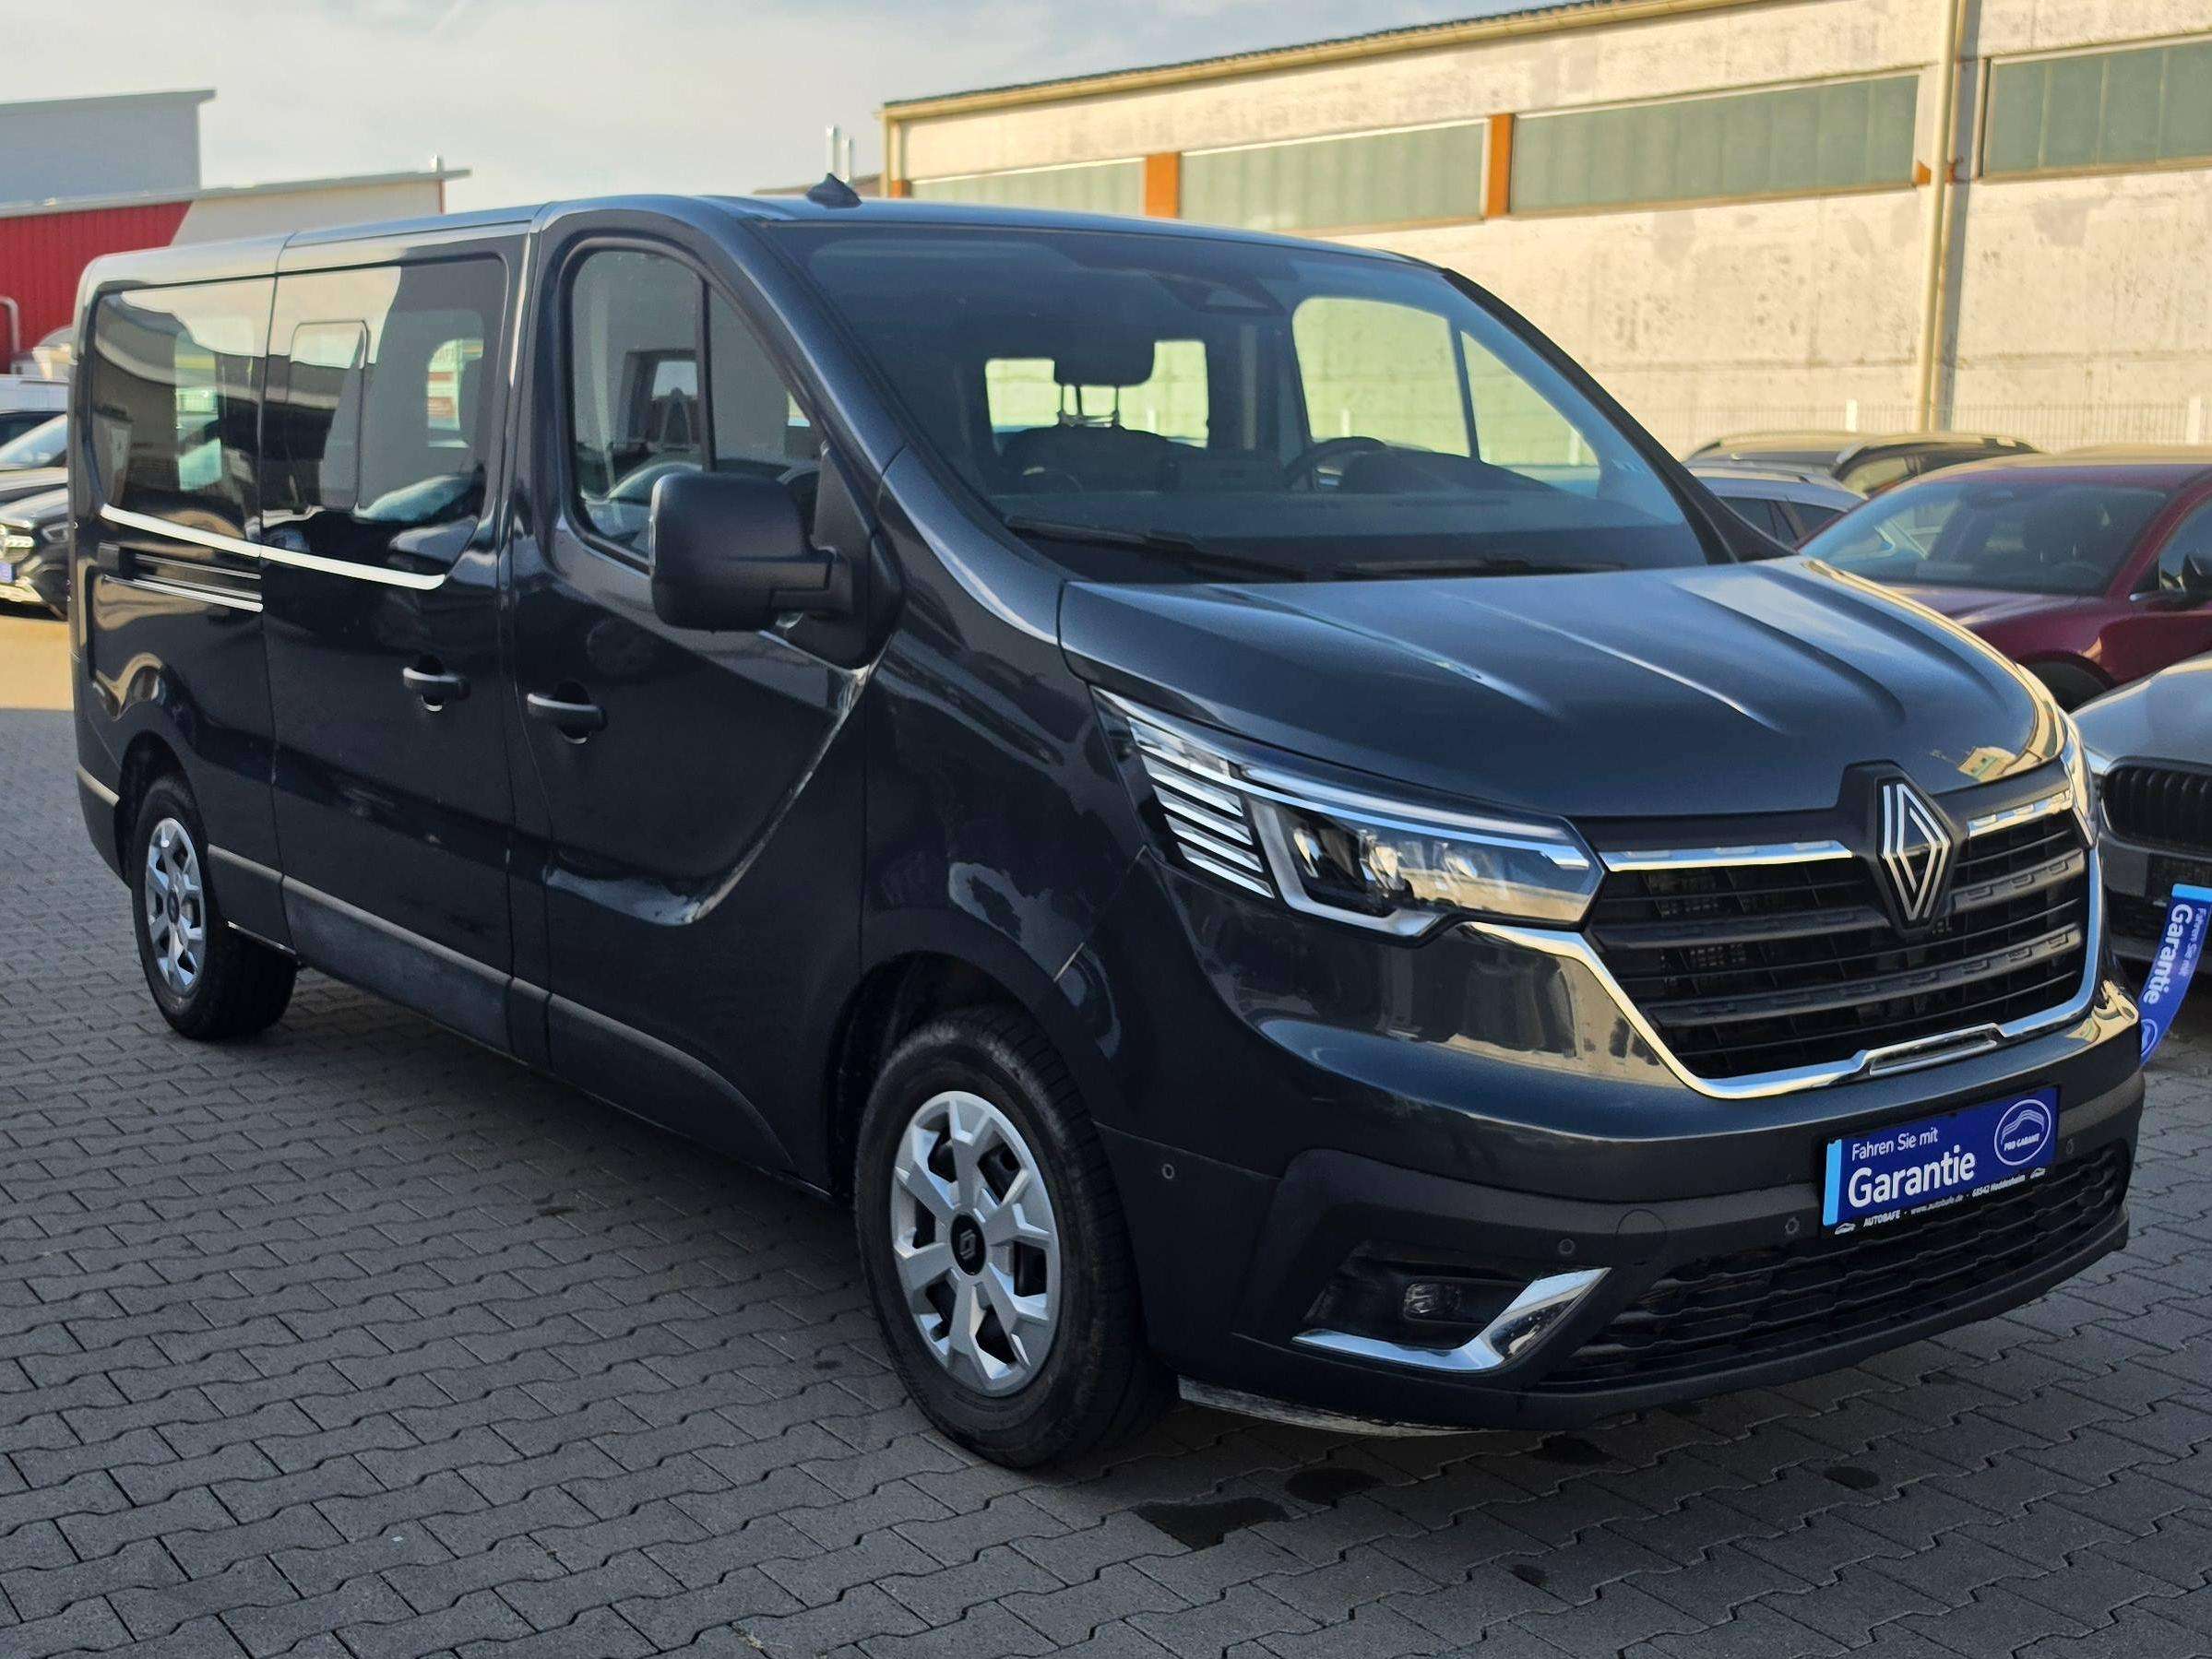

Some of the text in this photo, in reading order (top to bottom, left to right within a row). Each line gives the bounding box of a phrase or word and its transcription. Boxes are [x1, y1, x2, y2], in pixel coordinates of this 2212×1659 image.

[2143, 904, 2193, 1004] Garantie
[1848, 1144, 1977, 1208] Garantie
[1852, 1127, 1939, 1161] Fahren Sie mit
